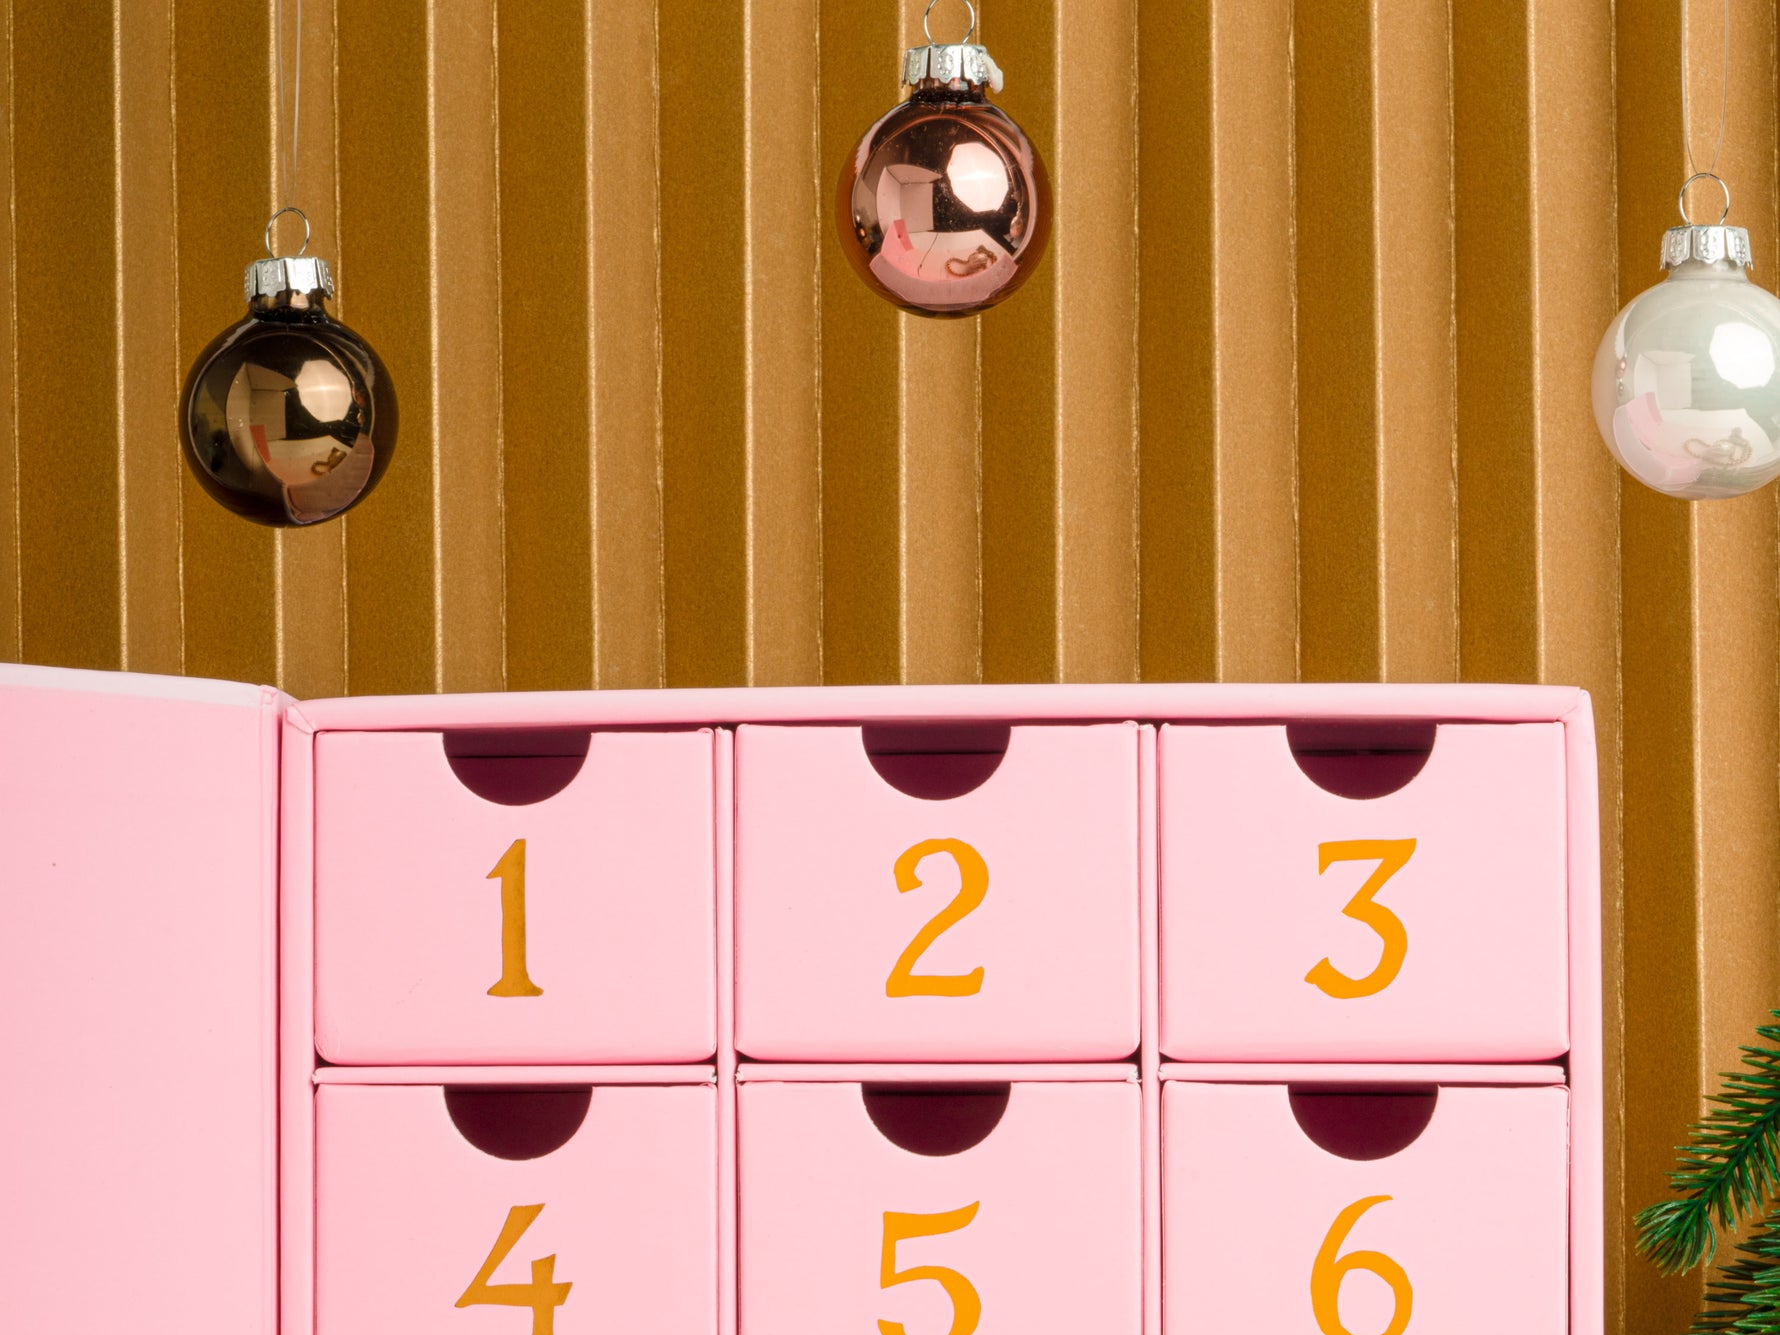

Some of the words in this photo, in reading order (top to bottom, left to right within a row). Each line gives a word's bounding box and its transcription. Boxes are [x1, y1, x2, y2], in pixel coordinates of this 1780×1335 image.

[487, 839, 543, 998] 1
[886, 838, 989, 998] 2
[1304, 838, 1417, 999] 3
